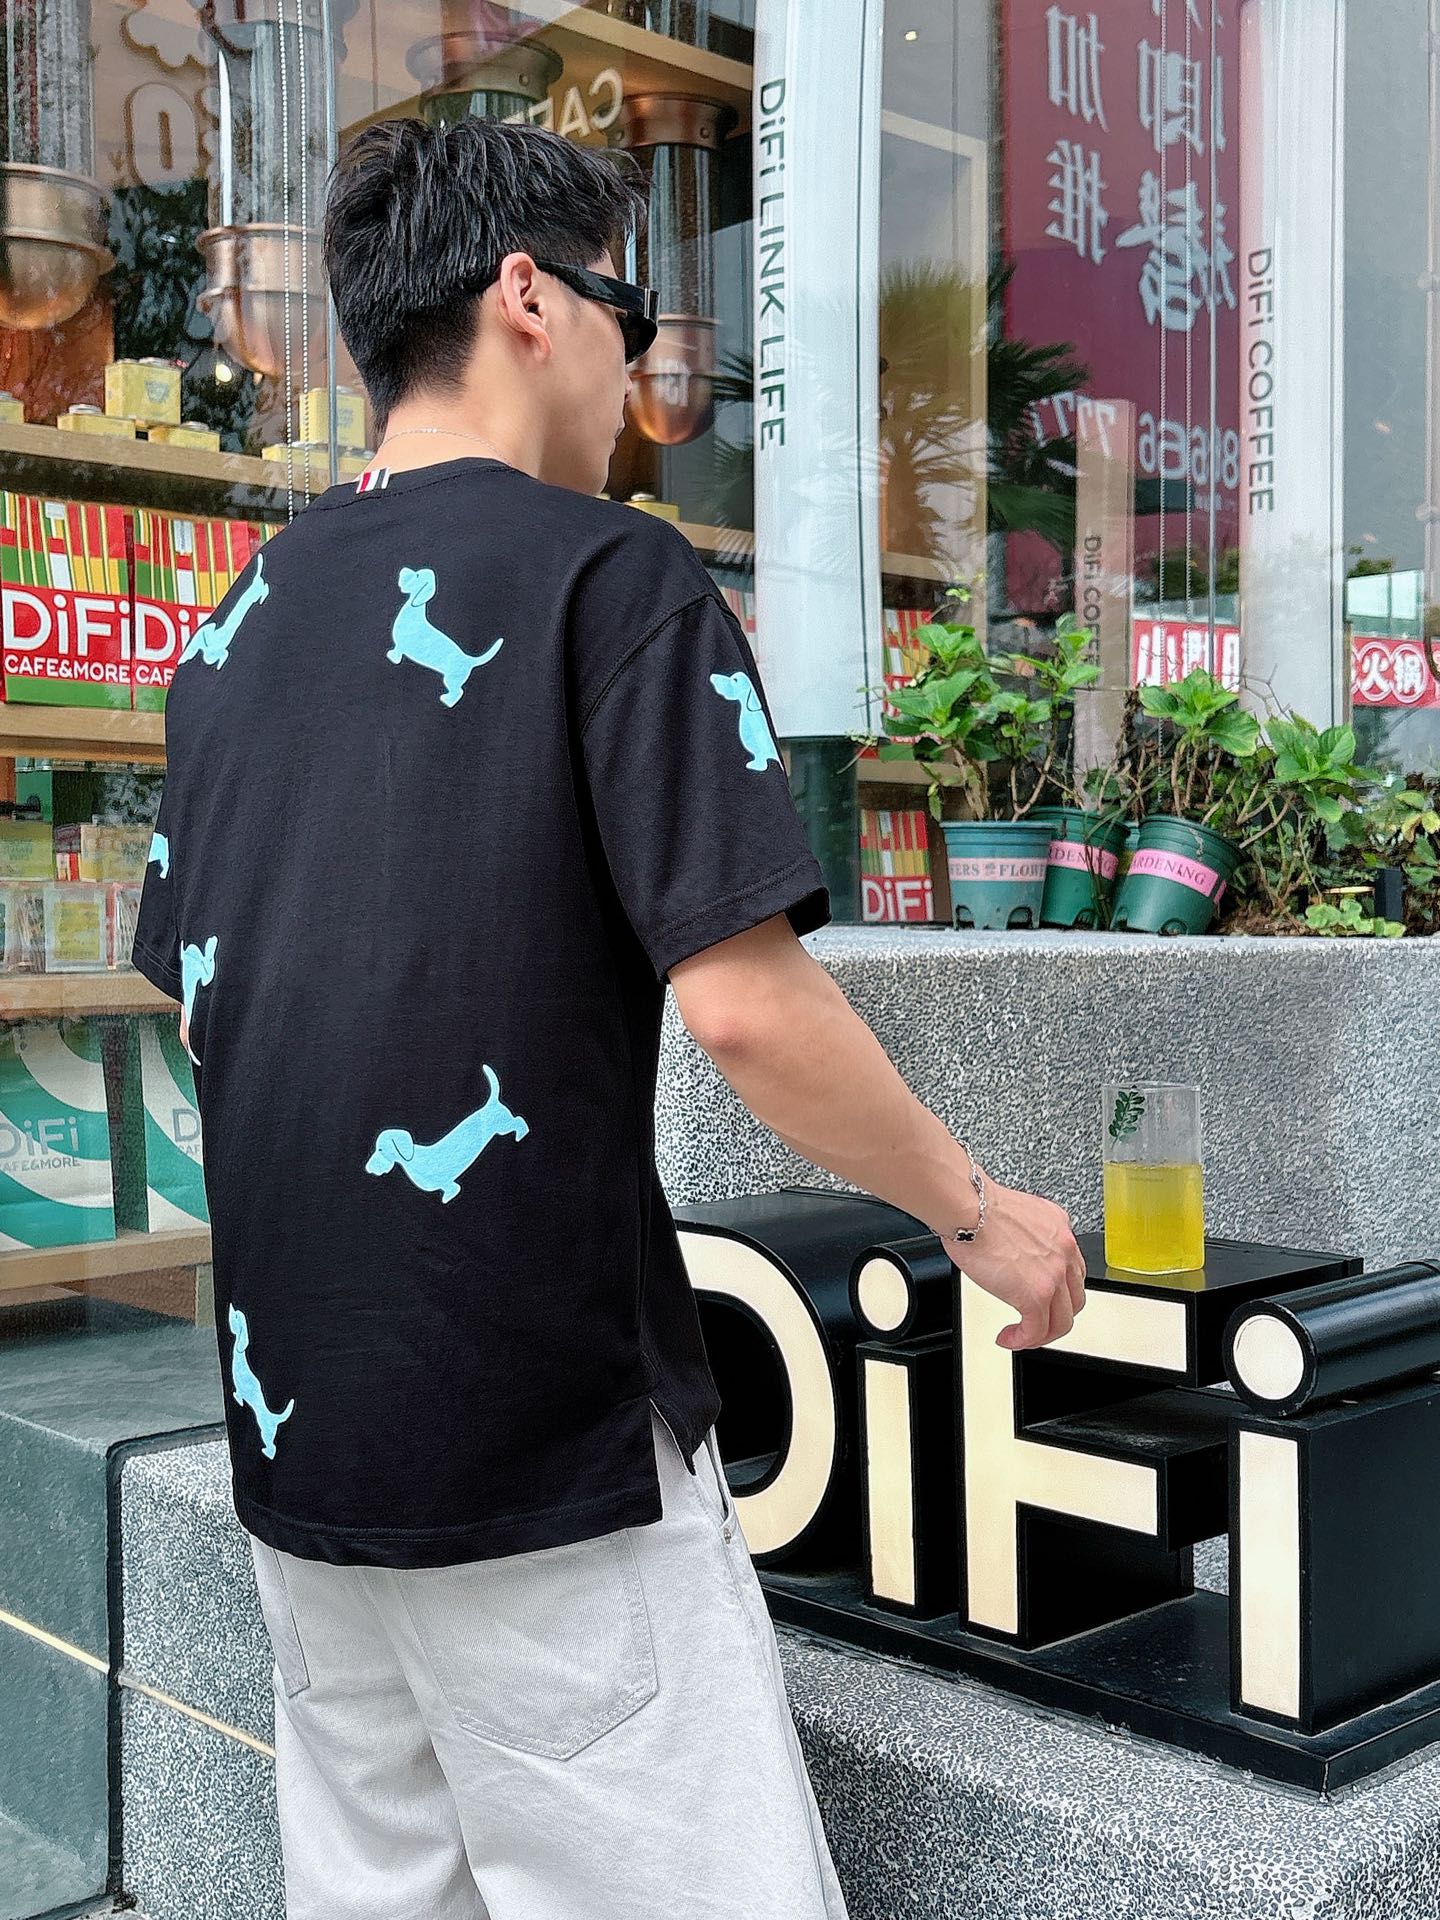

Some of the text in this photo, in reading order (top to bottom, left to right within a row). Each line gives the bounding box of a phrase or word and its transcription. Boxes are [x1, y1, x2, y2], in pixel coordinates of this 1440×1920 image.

[759, 78, 786, 452] DiFi LINK LIFE
[1247, 246, 1274, 516] DiFi COFFEE
[1, 589, 130, 661] DiFi
[4, 654, 131, 684] CAFE&MORE
[1351, 651, 1426, 696] 火锅
[862, 878, 935, 923] DiFi
[674, 1230, 1306, 1720] DiFi
